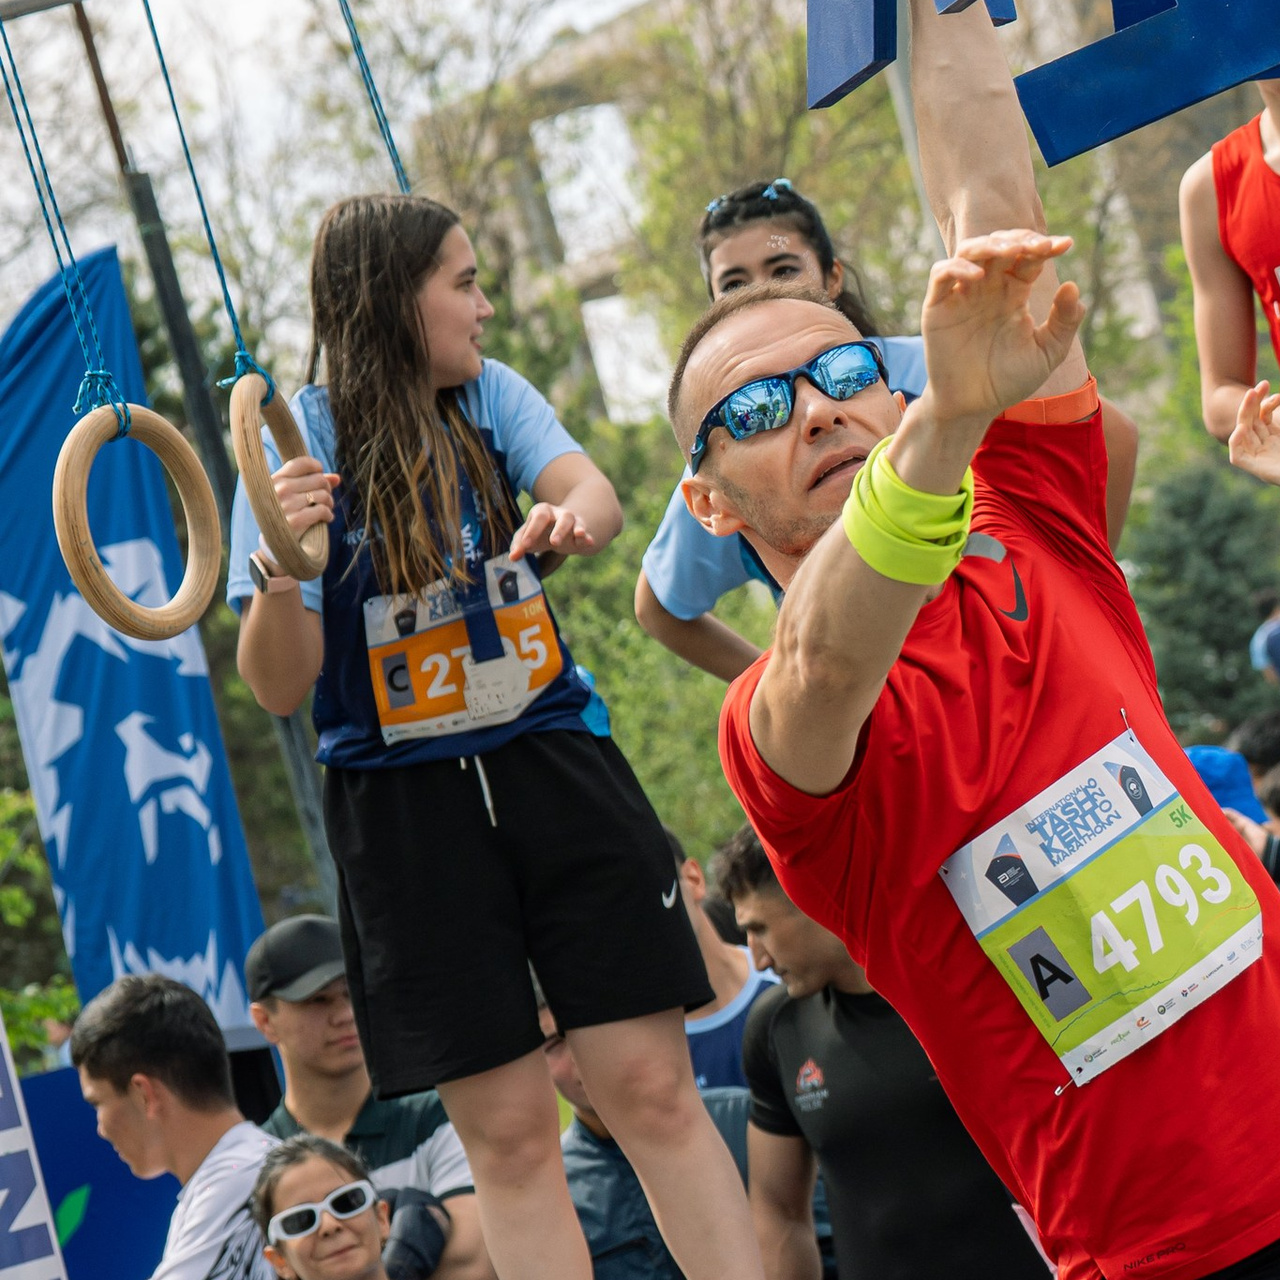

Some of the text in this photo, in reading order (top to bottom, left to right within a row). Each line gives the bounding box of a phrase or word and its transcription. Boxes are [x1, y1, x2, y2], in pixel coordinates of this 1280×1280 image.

[522, 603, 545, 619] 10K
[387, 624, 547, 699] C 25
[1025, 785, 1084, 830] INTERNATIONAL
[1029, 786, 1099, 841] TASH
[1169, 804, 1193, 829] 5K
[1039, 806, 1103, 863] KENT
[1053, 821, 1114, 867] MARATHON
[1090, 843, 1232, 975] 4793
[1029, 952, 1074, 1001] A
[1123, 1241, 1186, 1271] NIKE PRO
